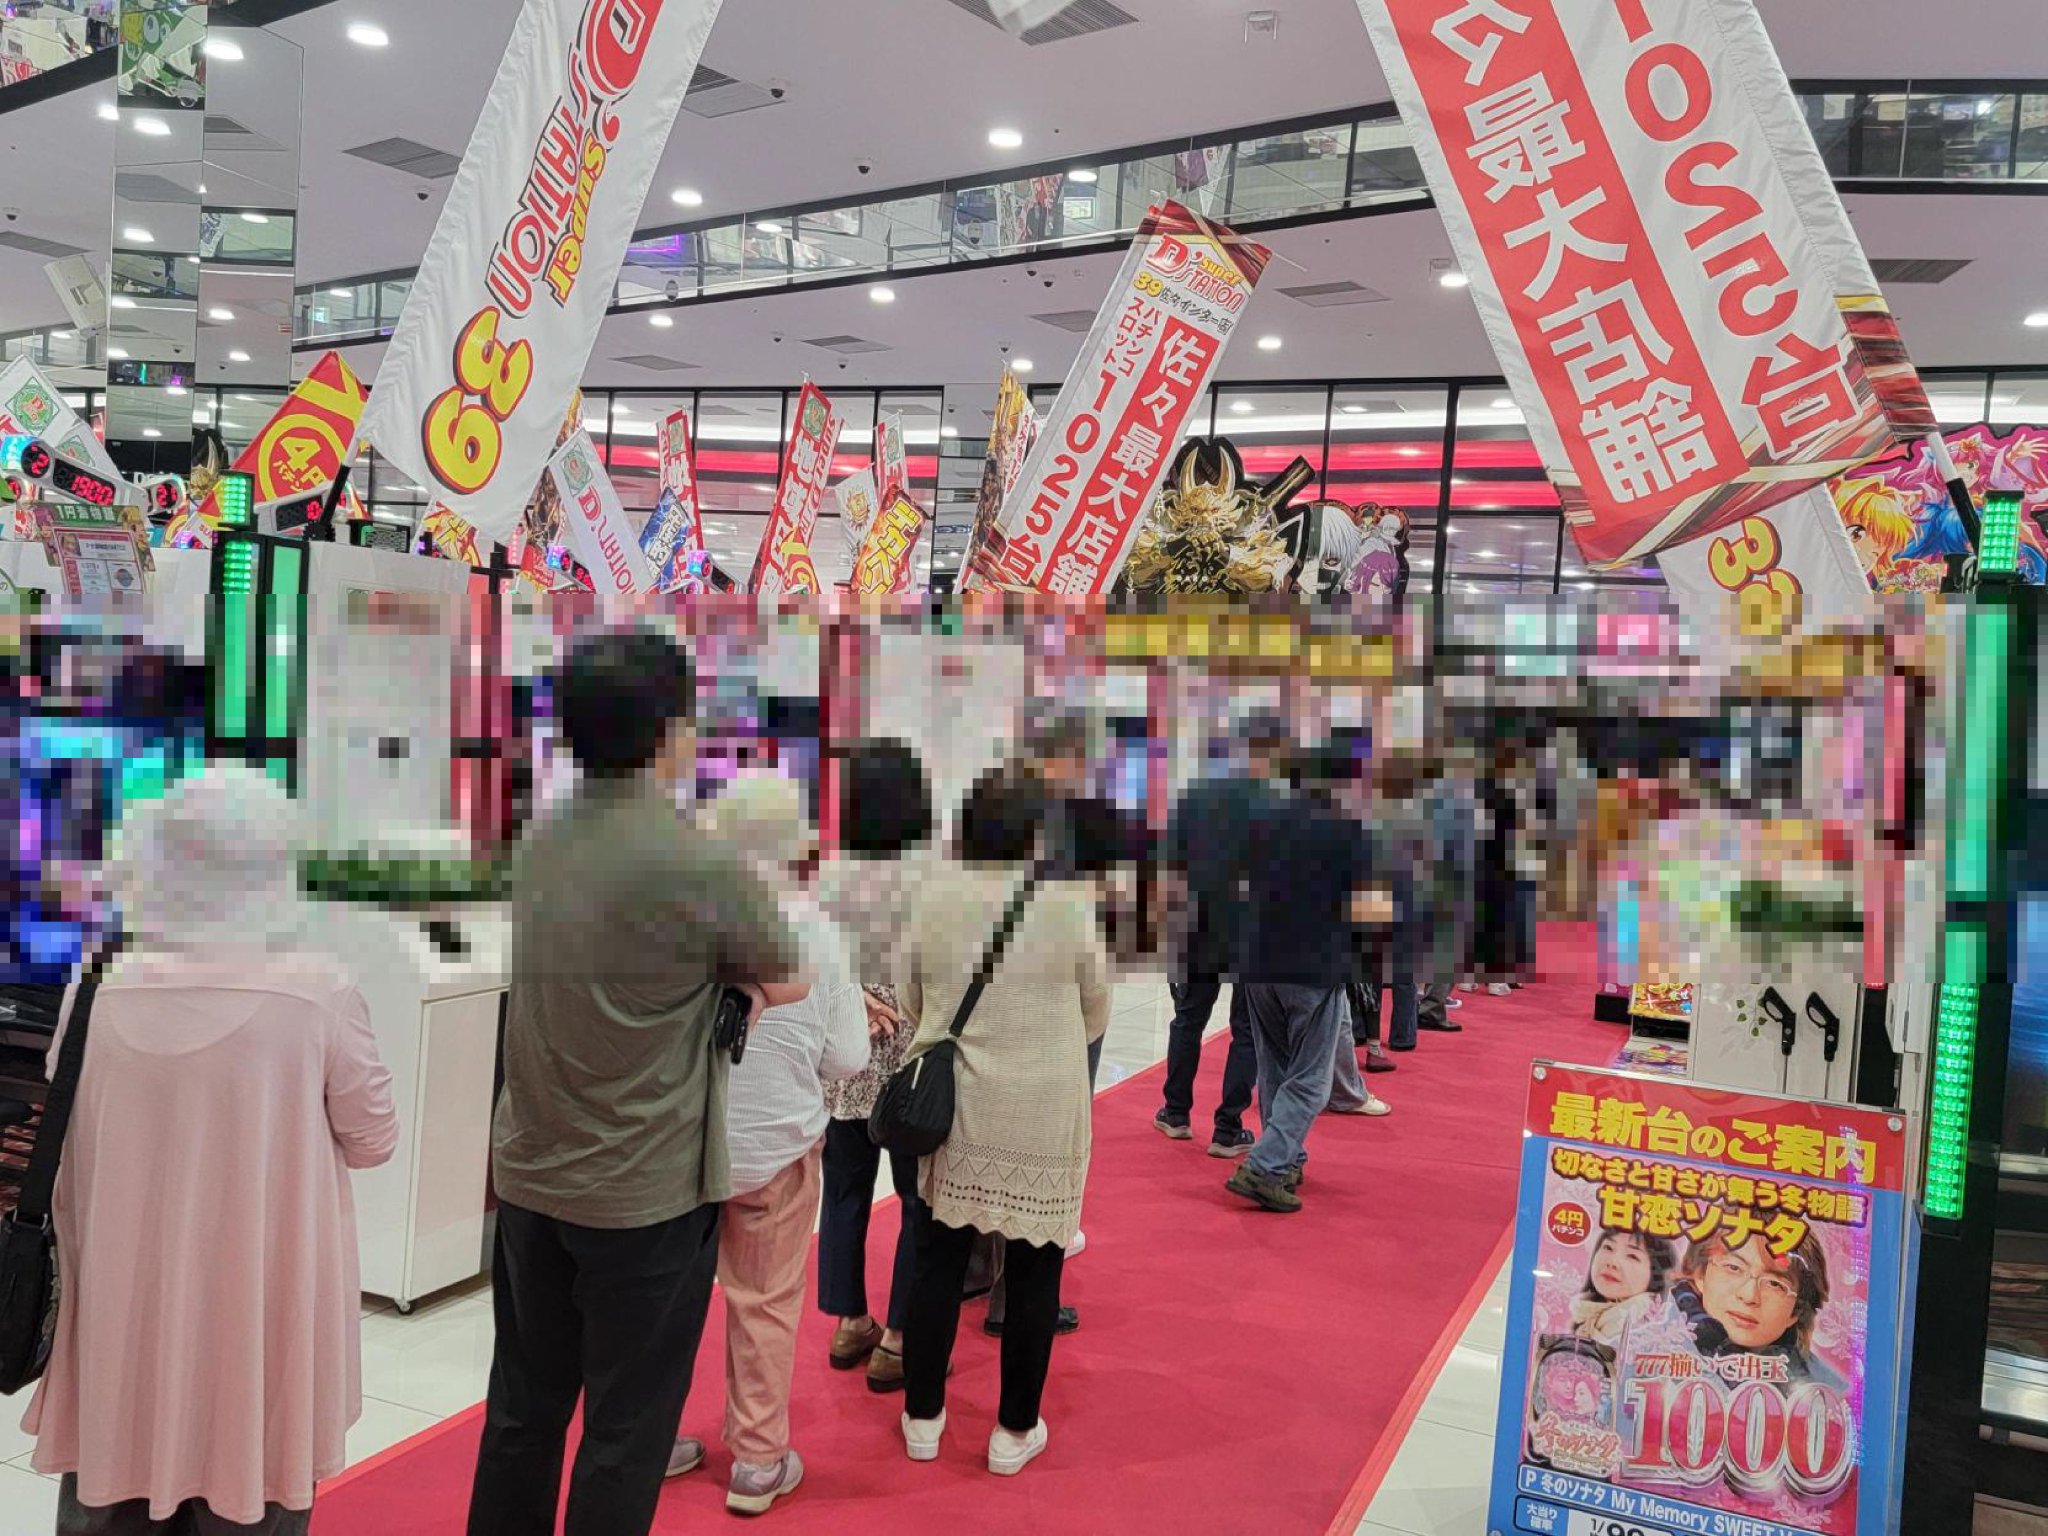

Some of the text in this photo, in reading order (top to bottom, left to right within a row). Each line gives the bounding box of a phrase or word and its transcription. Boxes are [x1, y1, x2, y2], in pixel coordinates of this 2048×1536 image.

[544, 134, 606, 304] super
[1146, 233, 1245, 314] D'STATION
[1200, 255, 1244, 287] super
[422, 305, 534, 495] 39
[998, 374, 1116, 584] 1025台
[1550, 1091, 1876, 1184] 最新台のご案内
[1554, 1148, 1866, 1226] 切なさと甘さが舞う冬物語
[1554, 1210, 1584, 1227] 4円
[1599, 1188, 1808, 1255] 甘恋ソナタ
[1551, 1225, 1585, 1237] パチンコ
[1635, 1354, 1788, 1383] 777揃いで出玉
[1624, 1380, 1852, 1482] 1000
[1525, 1471, 1537, 1487] P
[1541, 1474, 1606, 1505] 冬のソナタ
[1611, 1491, 1636, 1515] My
[1640, 1497, 1708, 1533] Memory
[1526, 1503, 1558, 1519] 大当り
